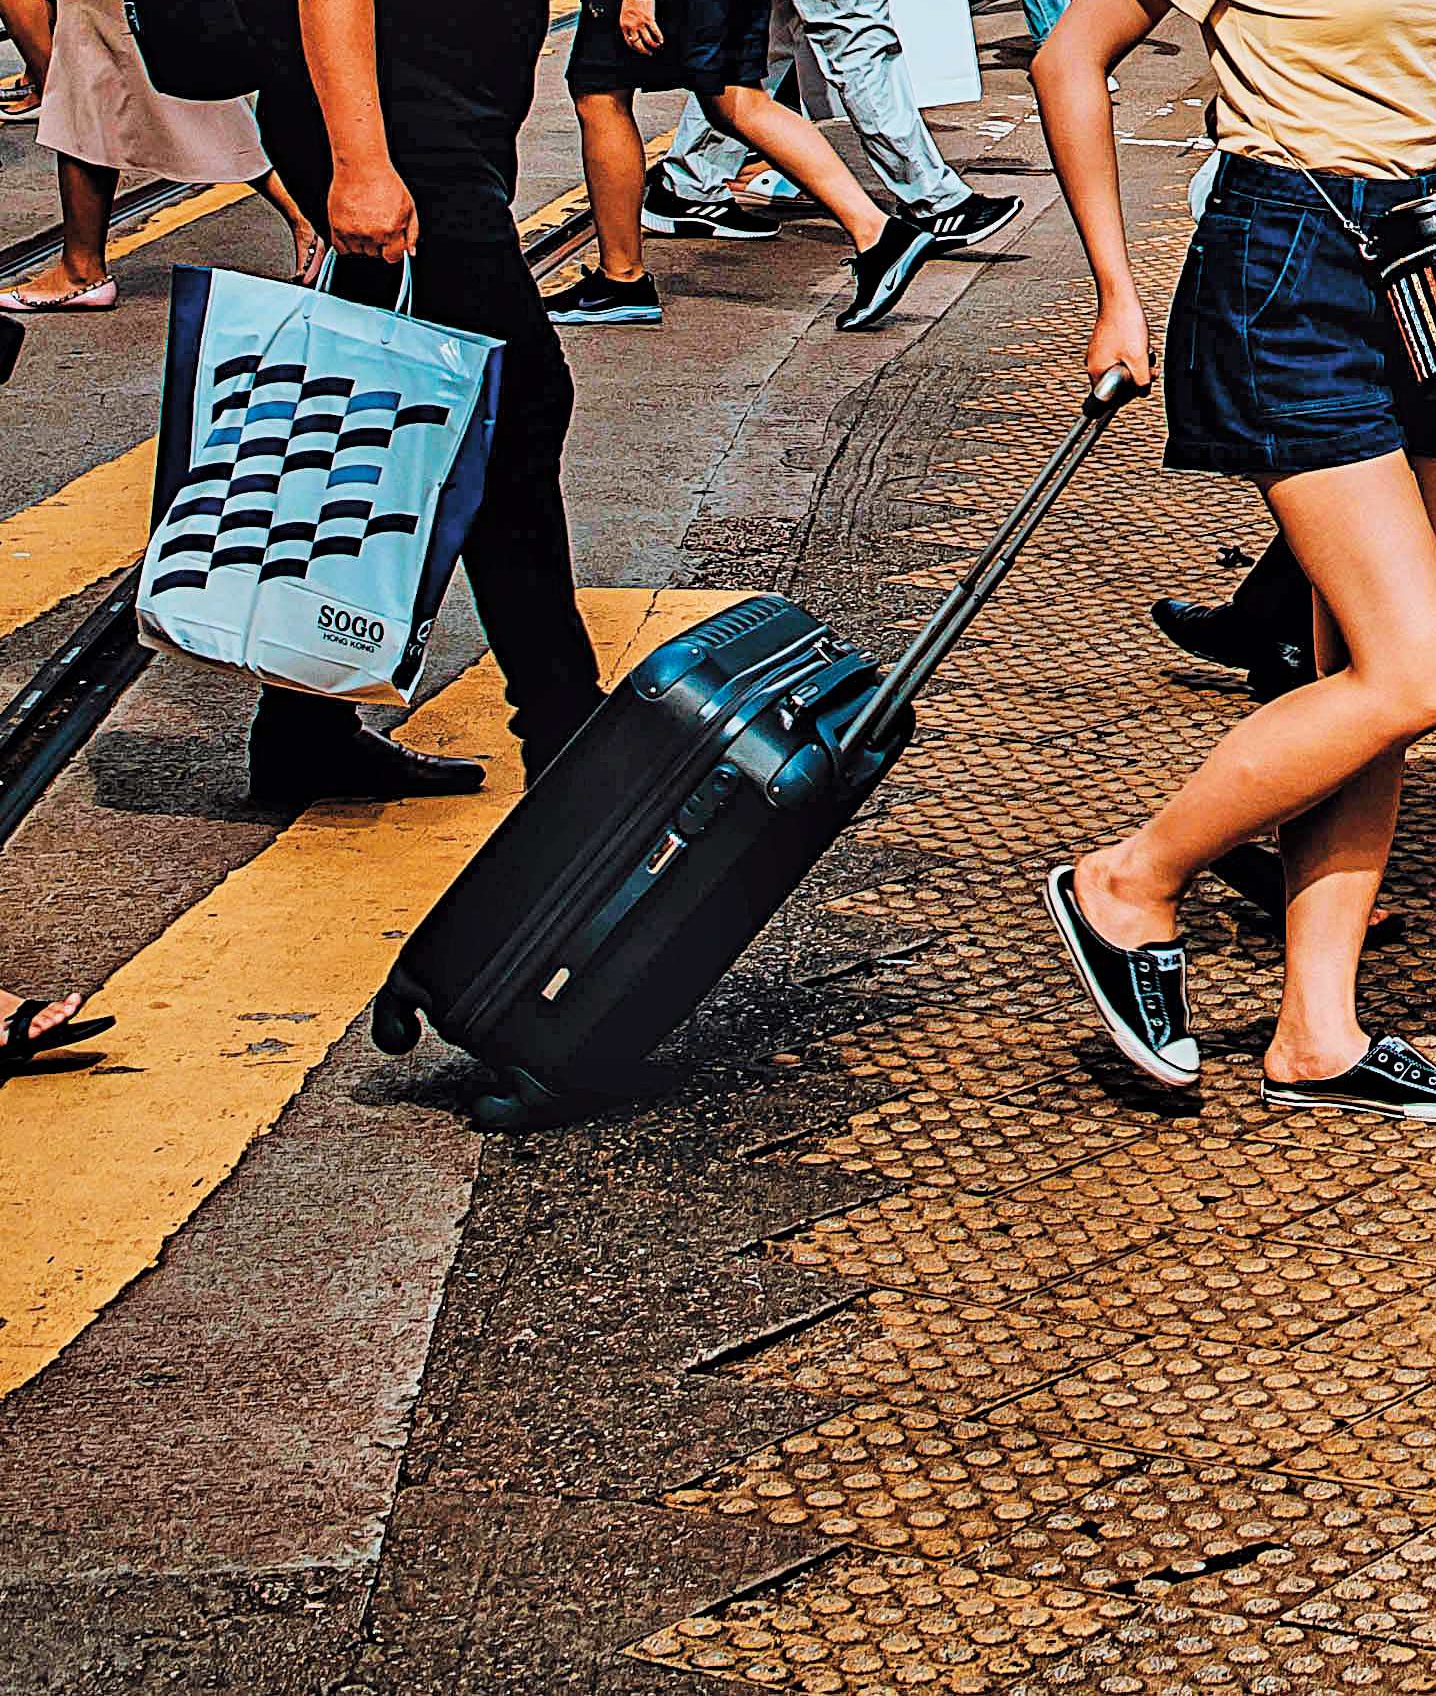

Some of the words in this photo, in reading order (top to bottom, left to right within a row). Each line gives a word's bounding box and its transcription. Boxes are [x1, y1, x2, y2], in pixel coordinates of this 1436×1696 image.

[317, 604, 385, 643] SOGO
[322, 632, 348, 647] HONG
[348, 637, 376, 654] KONG
